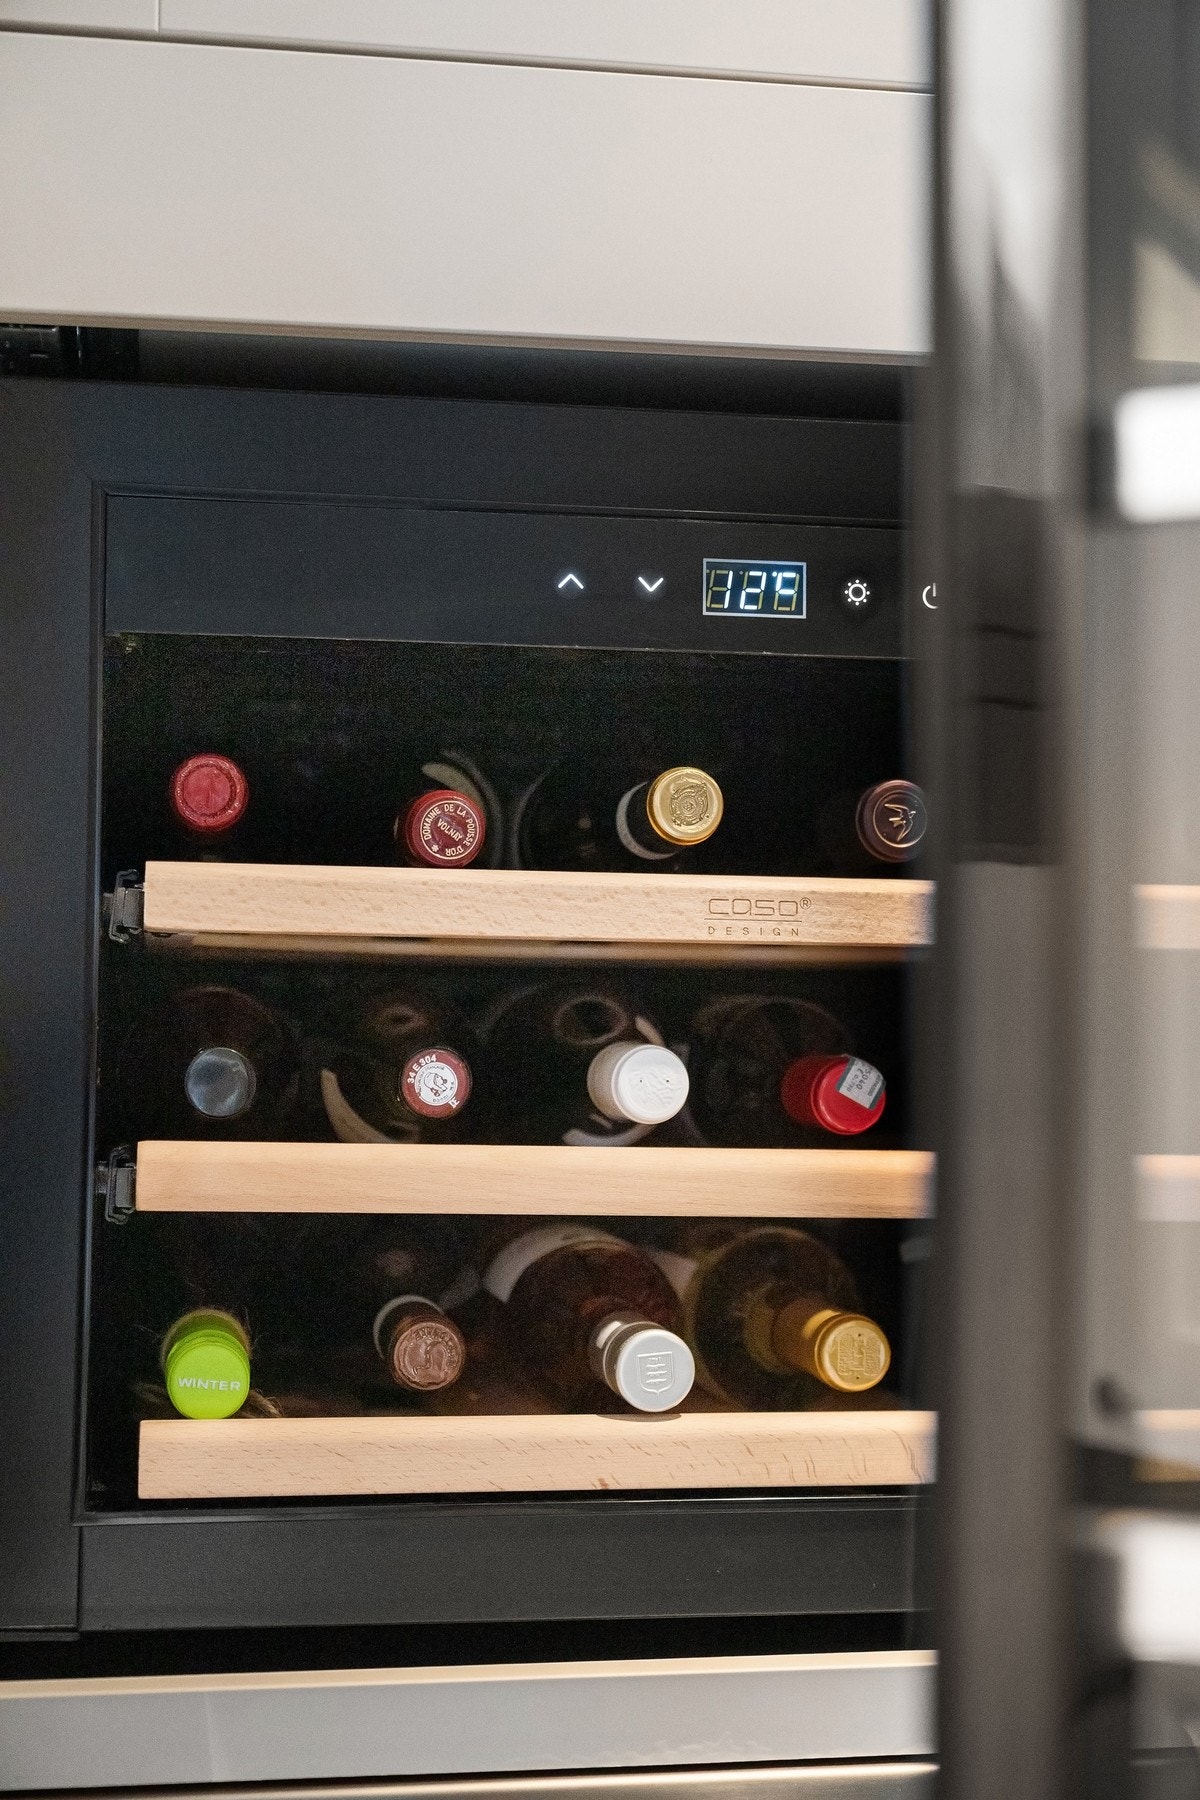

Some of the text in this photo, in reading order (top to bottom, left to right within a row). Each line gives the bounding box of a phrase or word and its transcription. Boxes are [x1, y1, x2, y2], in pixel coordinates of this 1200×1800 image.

[423, 804, 476, 857] DOMAINE DE LA POUSSE D'OR
[437, 819, 462, 842] VOLNAY
[708, 926, 799, 937] DESIGN
[407, 1054, 437, 1084] 34 E 304
[177, 1377, 241, 1391] WINTER
